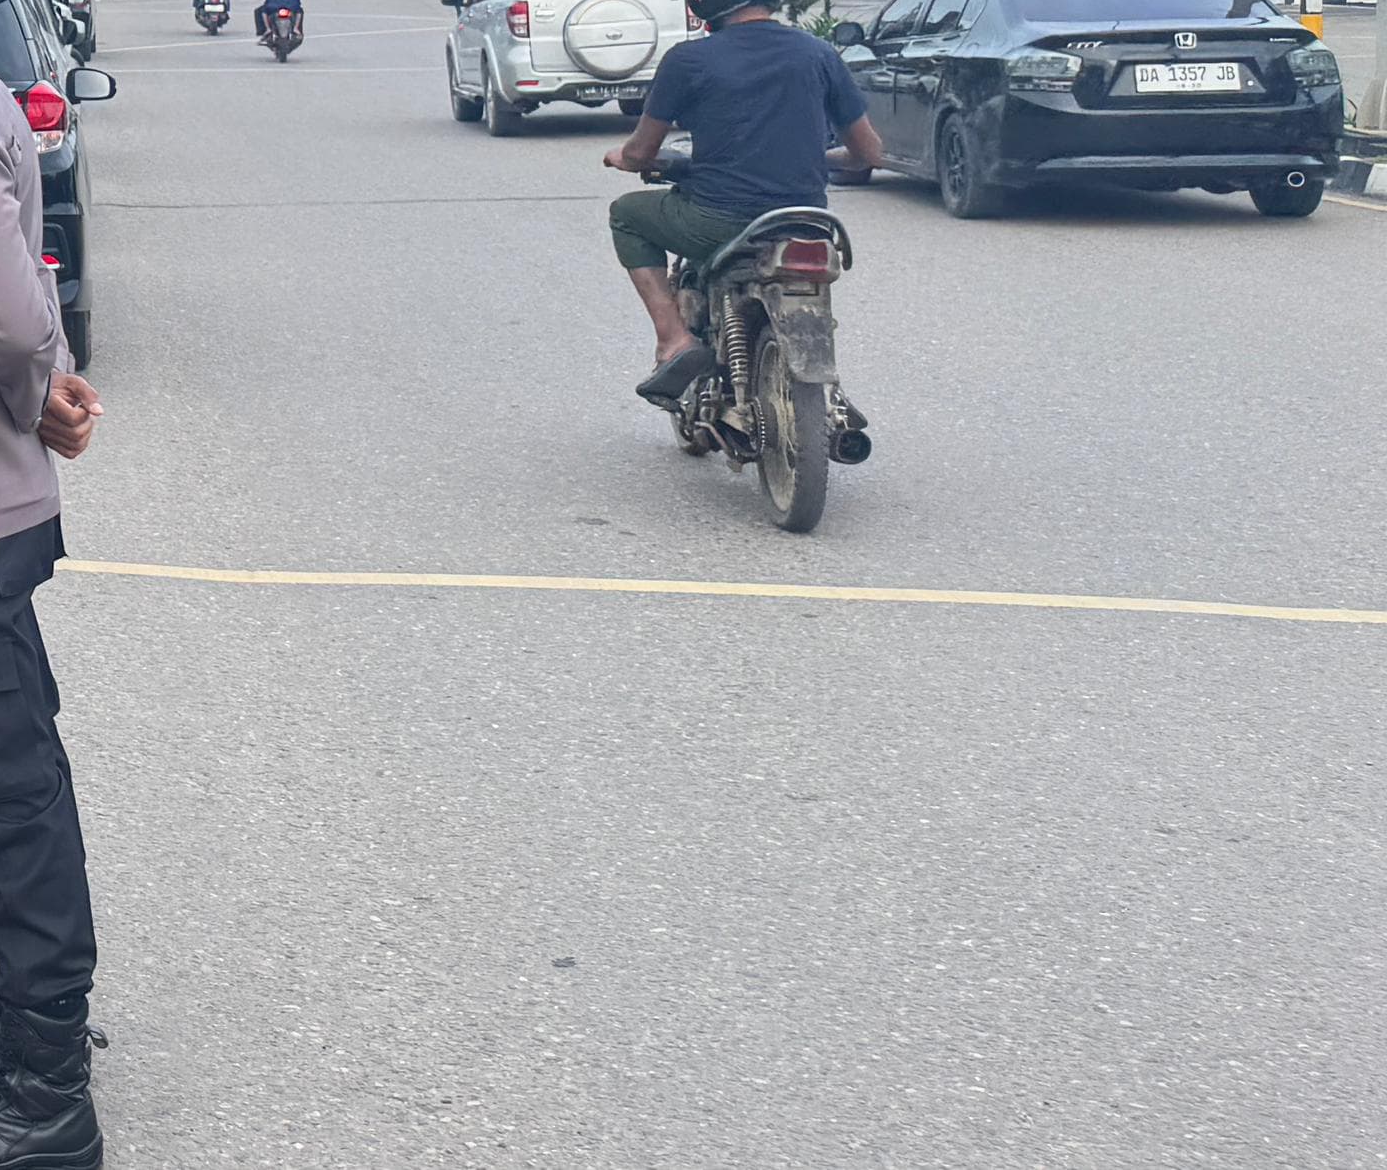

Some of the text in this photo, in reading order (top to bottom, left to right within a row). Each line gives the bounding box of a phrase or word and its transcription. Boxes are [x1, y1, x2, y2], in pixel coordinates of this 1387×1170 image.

[1140, 65, 1236, 82] DA 1357 JB
